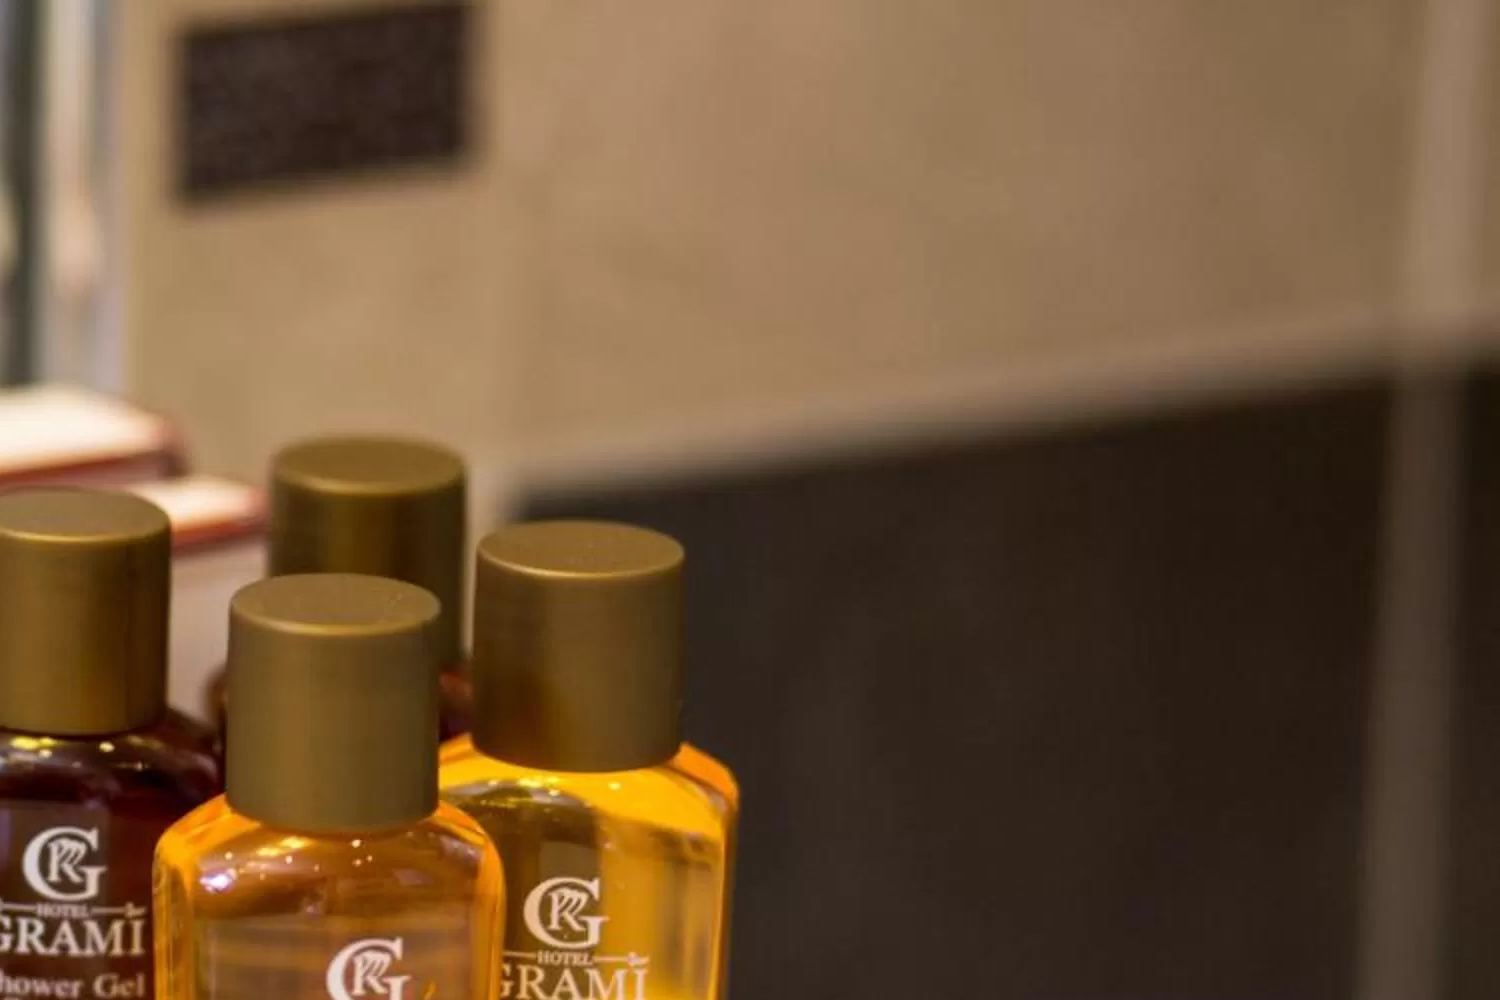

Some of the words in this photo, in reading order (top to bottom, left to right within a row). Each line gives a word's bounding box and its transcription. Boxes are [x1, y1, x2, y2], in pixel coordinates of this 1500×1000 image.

[36, 903, 93, 918] HOTEL
[537, 950, 595, 967] HOTEL
[93, 973, 145, 998] Gel
